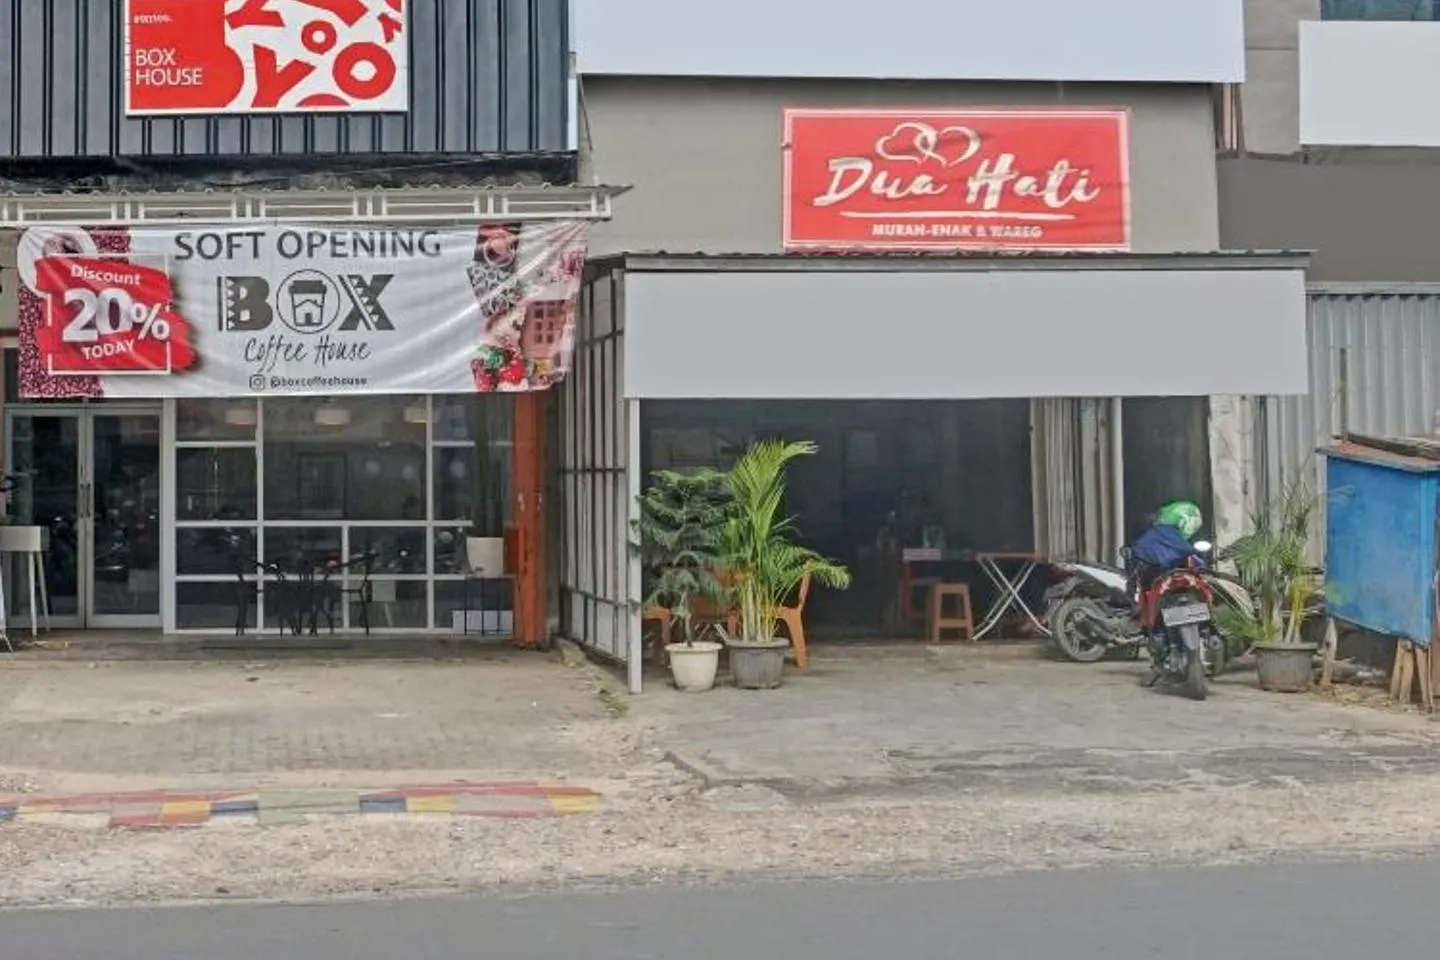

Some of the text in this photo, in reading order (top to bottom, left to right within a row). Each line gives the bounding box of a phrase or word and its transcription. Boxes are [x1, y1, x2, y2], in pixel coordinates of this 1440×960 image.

[135, 48, 177, 66] BOX
[135, 67, 203, 86] HOUSE
[813, 153, 1100, 210] Dua Hati
[174, 230, 441, 260] SOFT OPENING
[71, 264, 141, 285] Discount
[217, 268, 396, 334] BOX
[62, 287, 170, 342] 20%
[81, 339, 134, 360] TODAY
[244, 335, 372, 372] Coffee House
[269, 375, 368, 389] @boxcoffeehouse
